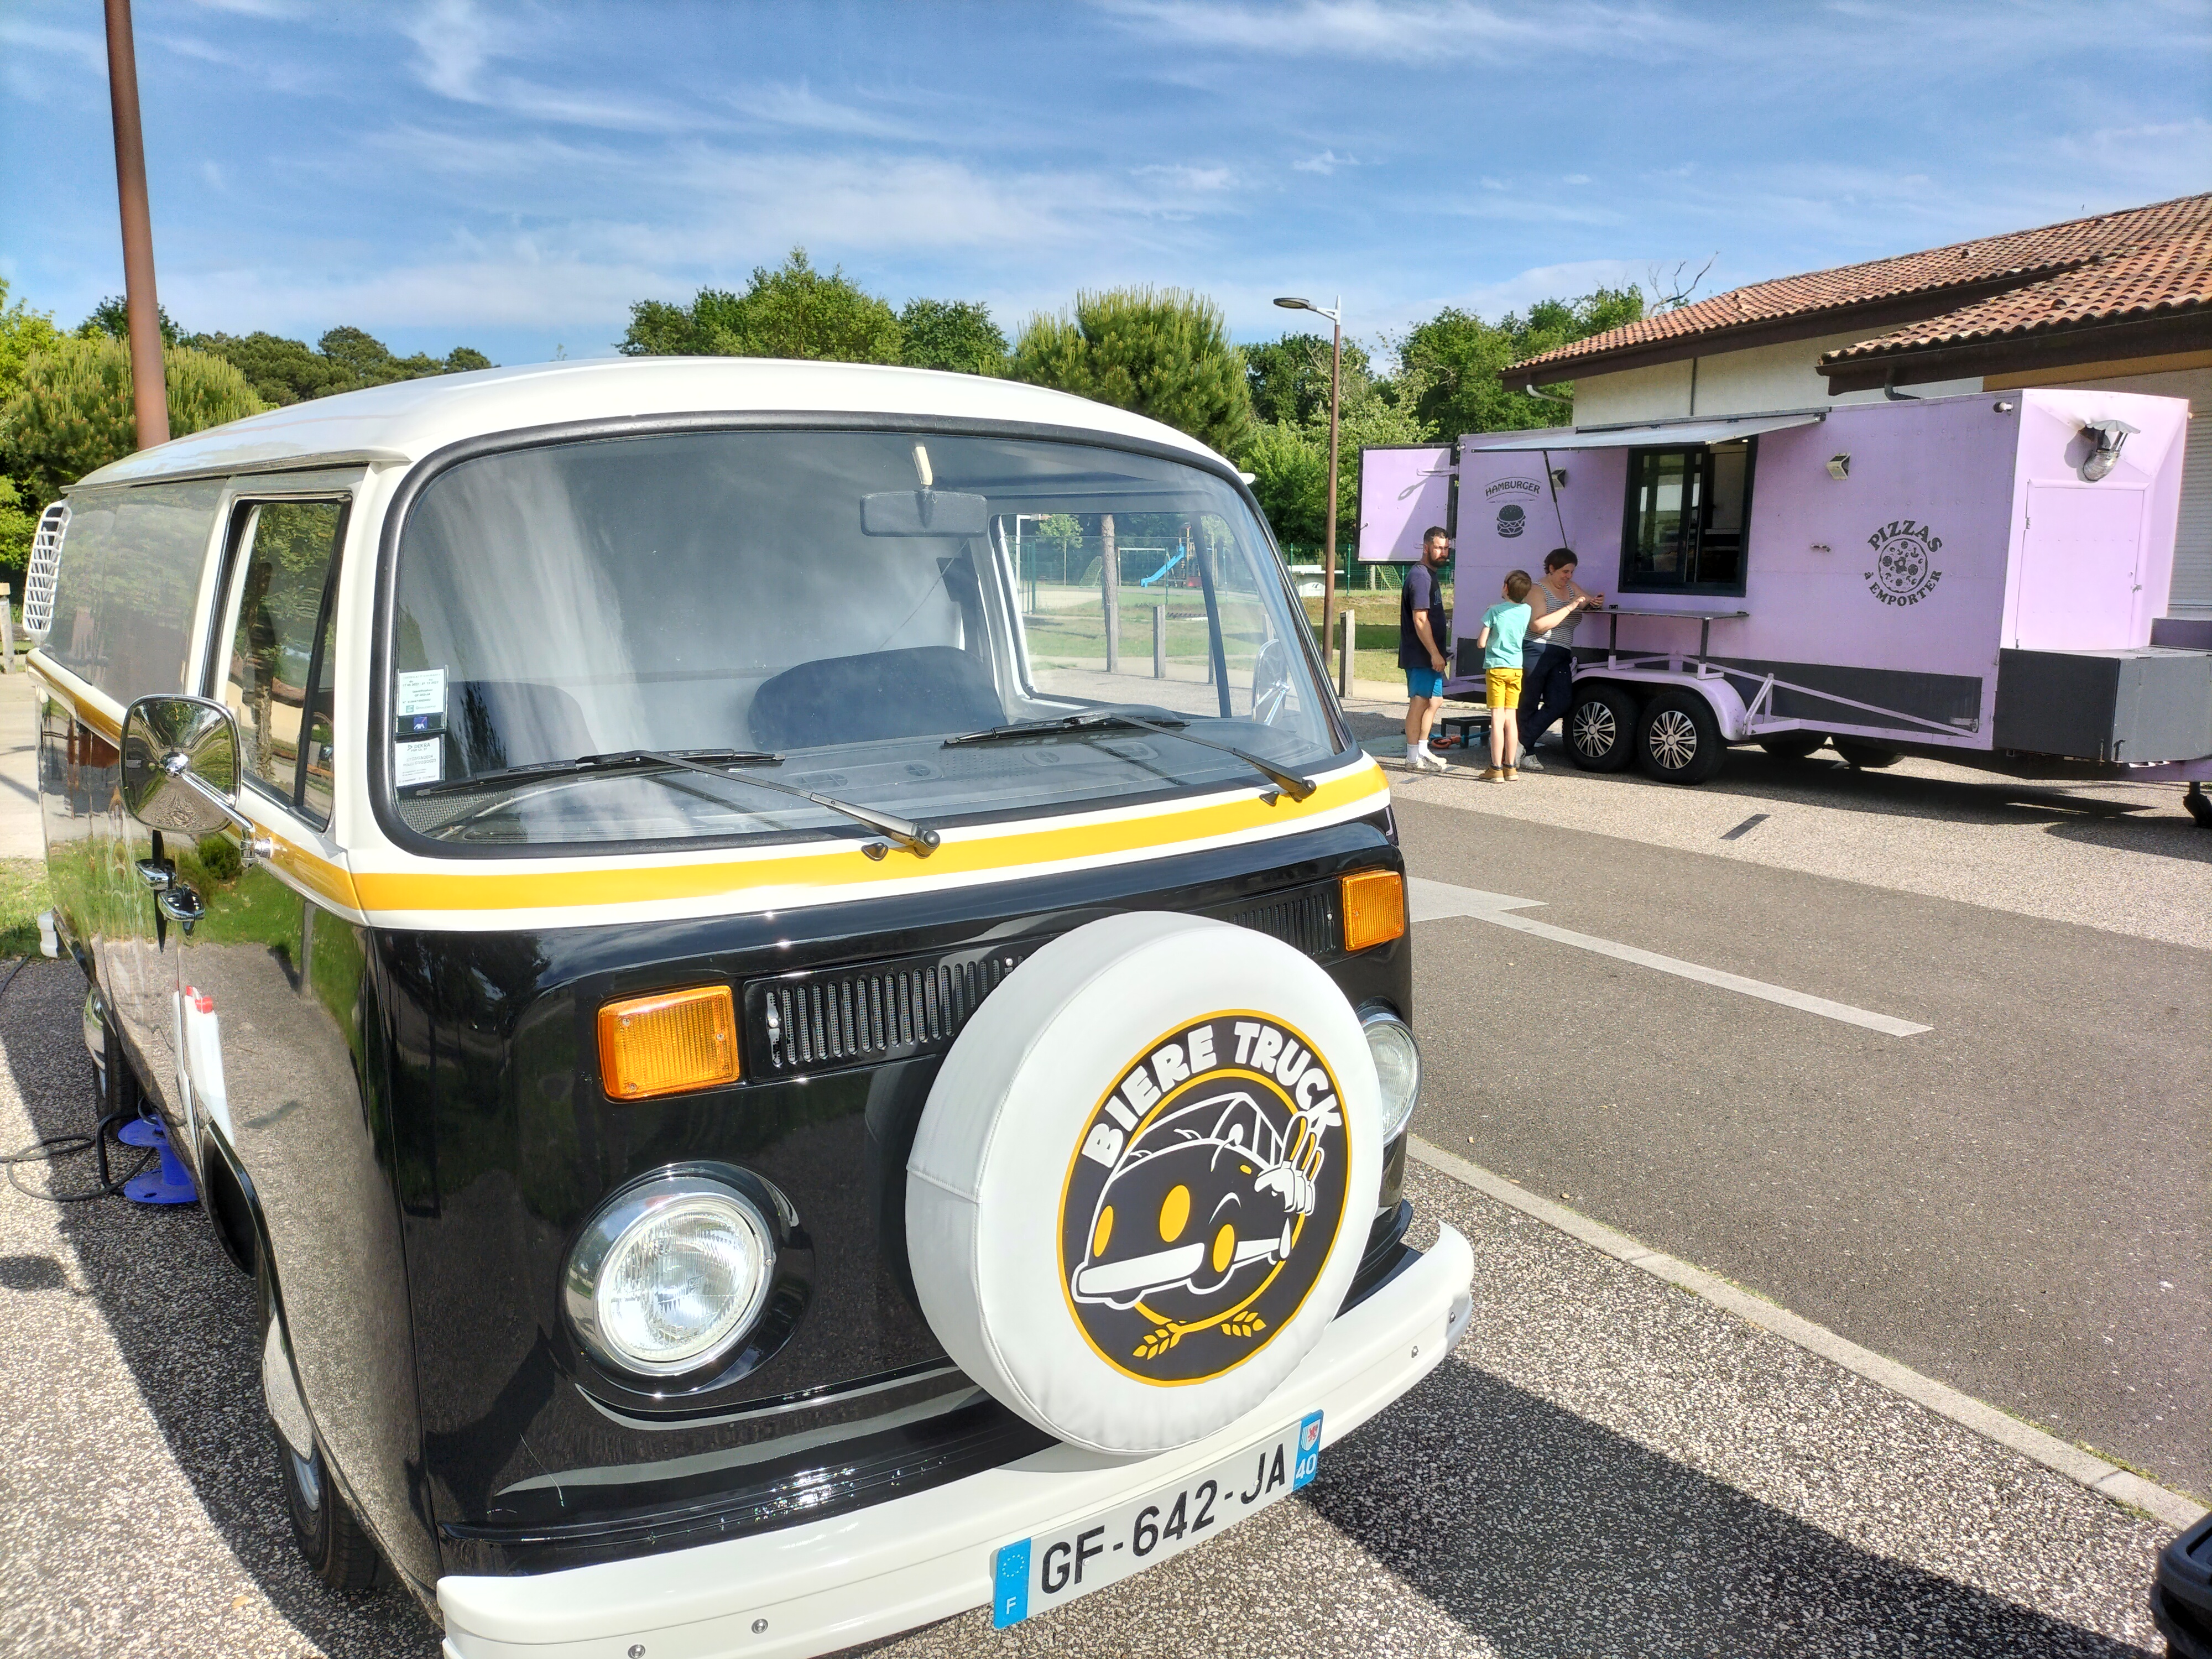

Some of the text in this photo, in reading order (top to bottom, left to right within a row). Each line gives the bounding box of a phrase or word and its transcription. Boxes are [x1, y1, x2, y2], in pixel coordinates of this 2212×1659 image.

[1485, 481, 1541, 497] HAMBURGER
[1867, 520, 1943, 552] PIZZAS
[1869, 571, 1942, 607] EMPORTER
[1081, 1021, 1342, 1168] BIERE TRUCK
[1296, 1453, 1317, 1480] 40
[1041, 1443, 1286, 1594] GF-642-JA
[1005, 1596, 1017, 1615] F
